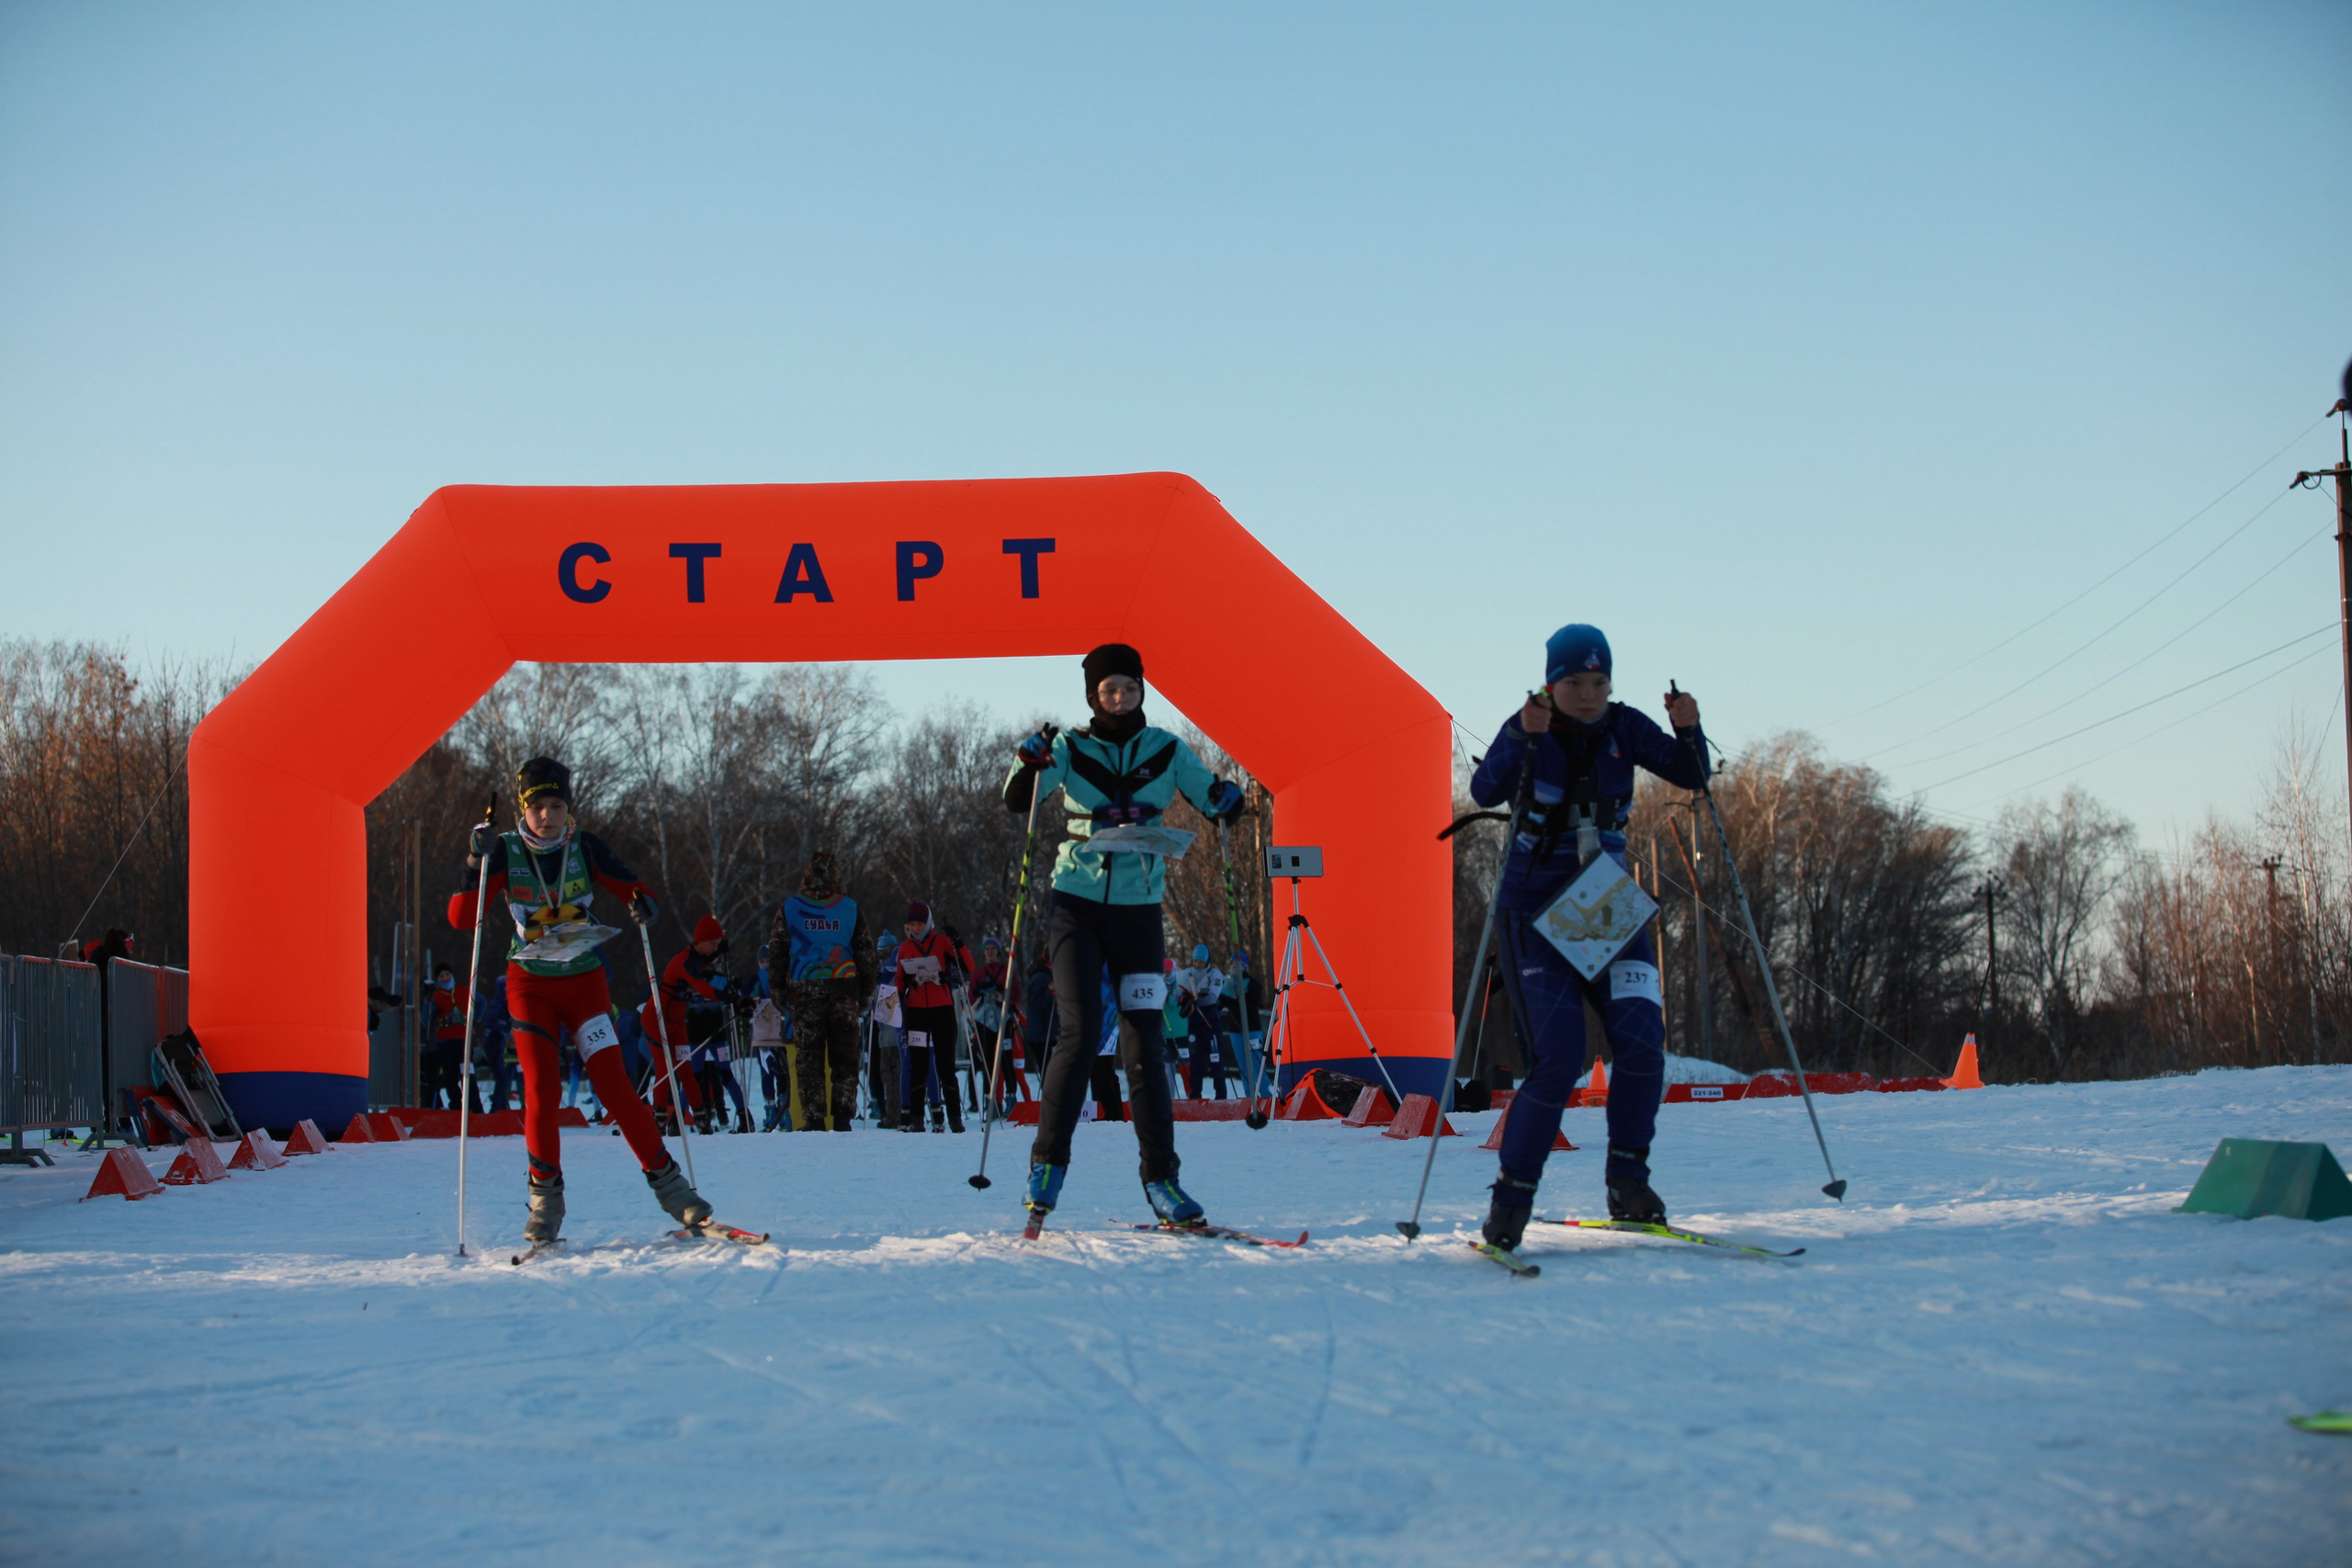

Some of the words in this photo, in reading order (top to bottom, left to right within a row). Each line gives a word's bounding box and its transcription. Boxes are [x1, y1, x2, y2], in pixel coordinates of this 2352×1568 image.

[558, 538, 1056, 604] СТАРТ
[804, 919, 840, 931] СУДЬЯ
[1625, 972, 1647, 984] 237
[1132, 987, 1153, 999] 435
[587, 1029, 606, 1045] 335
